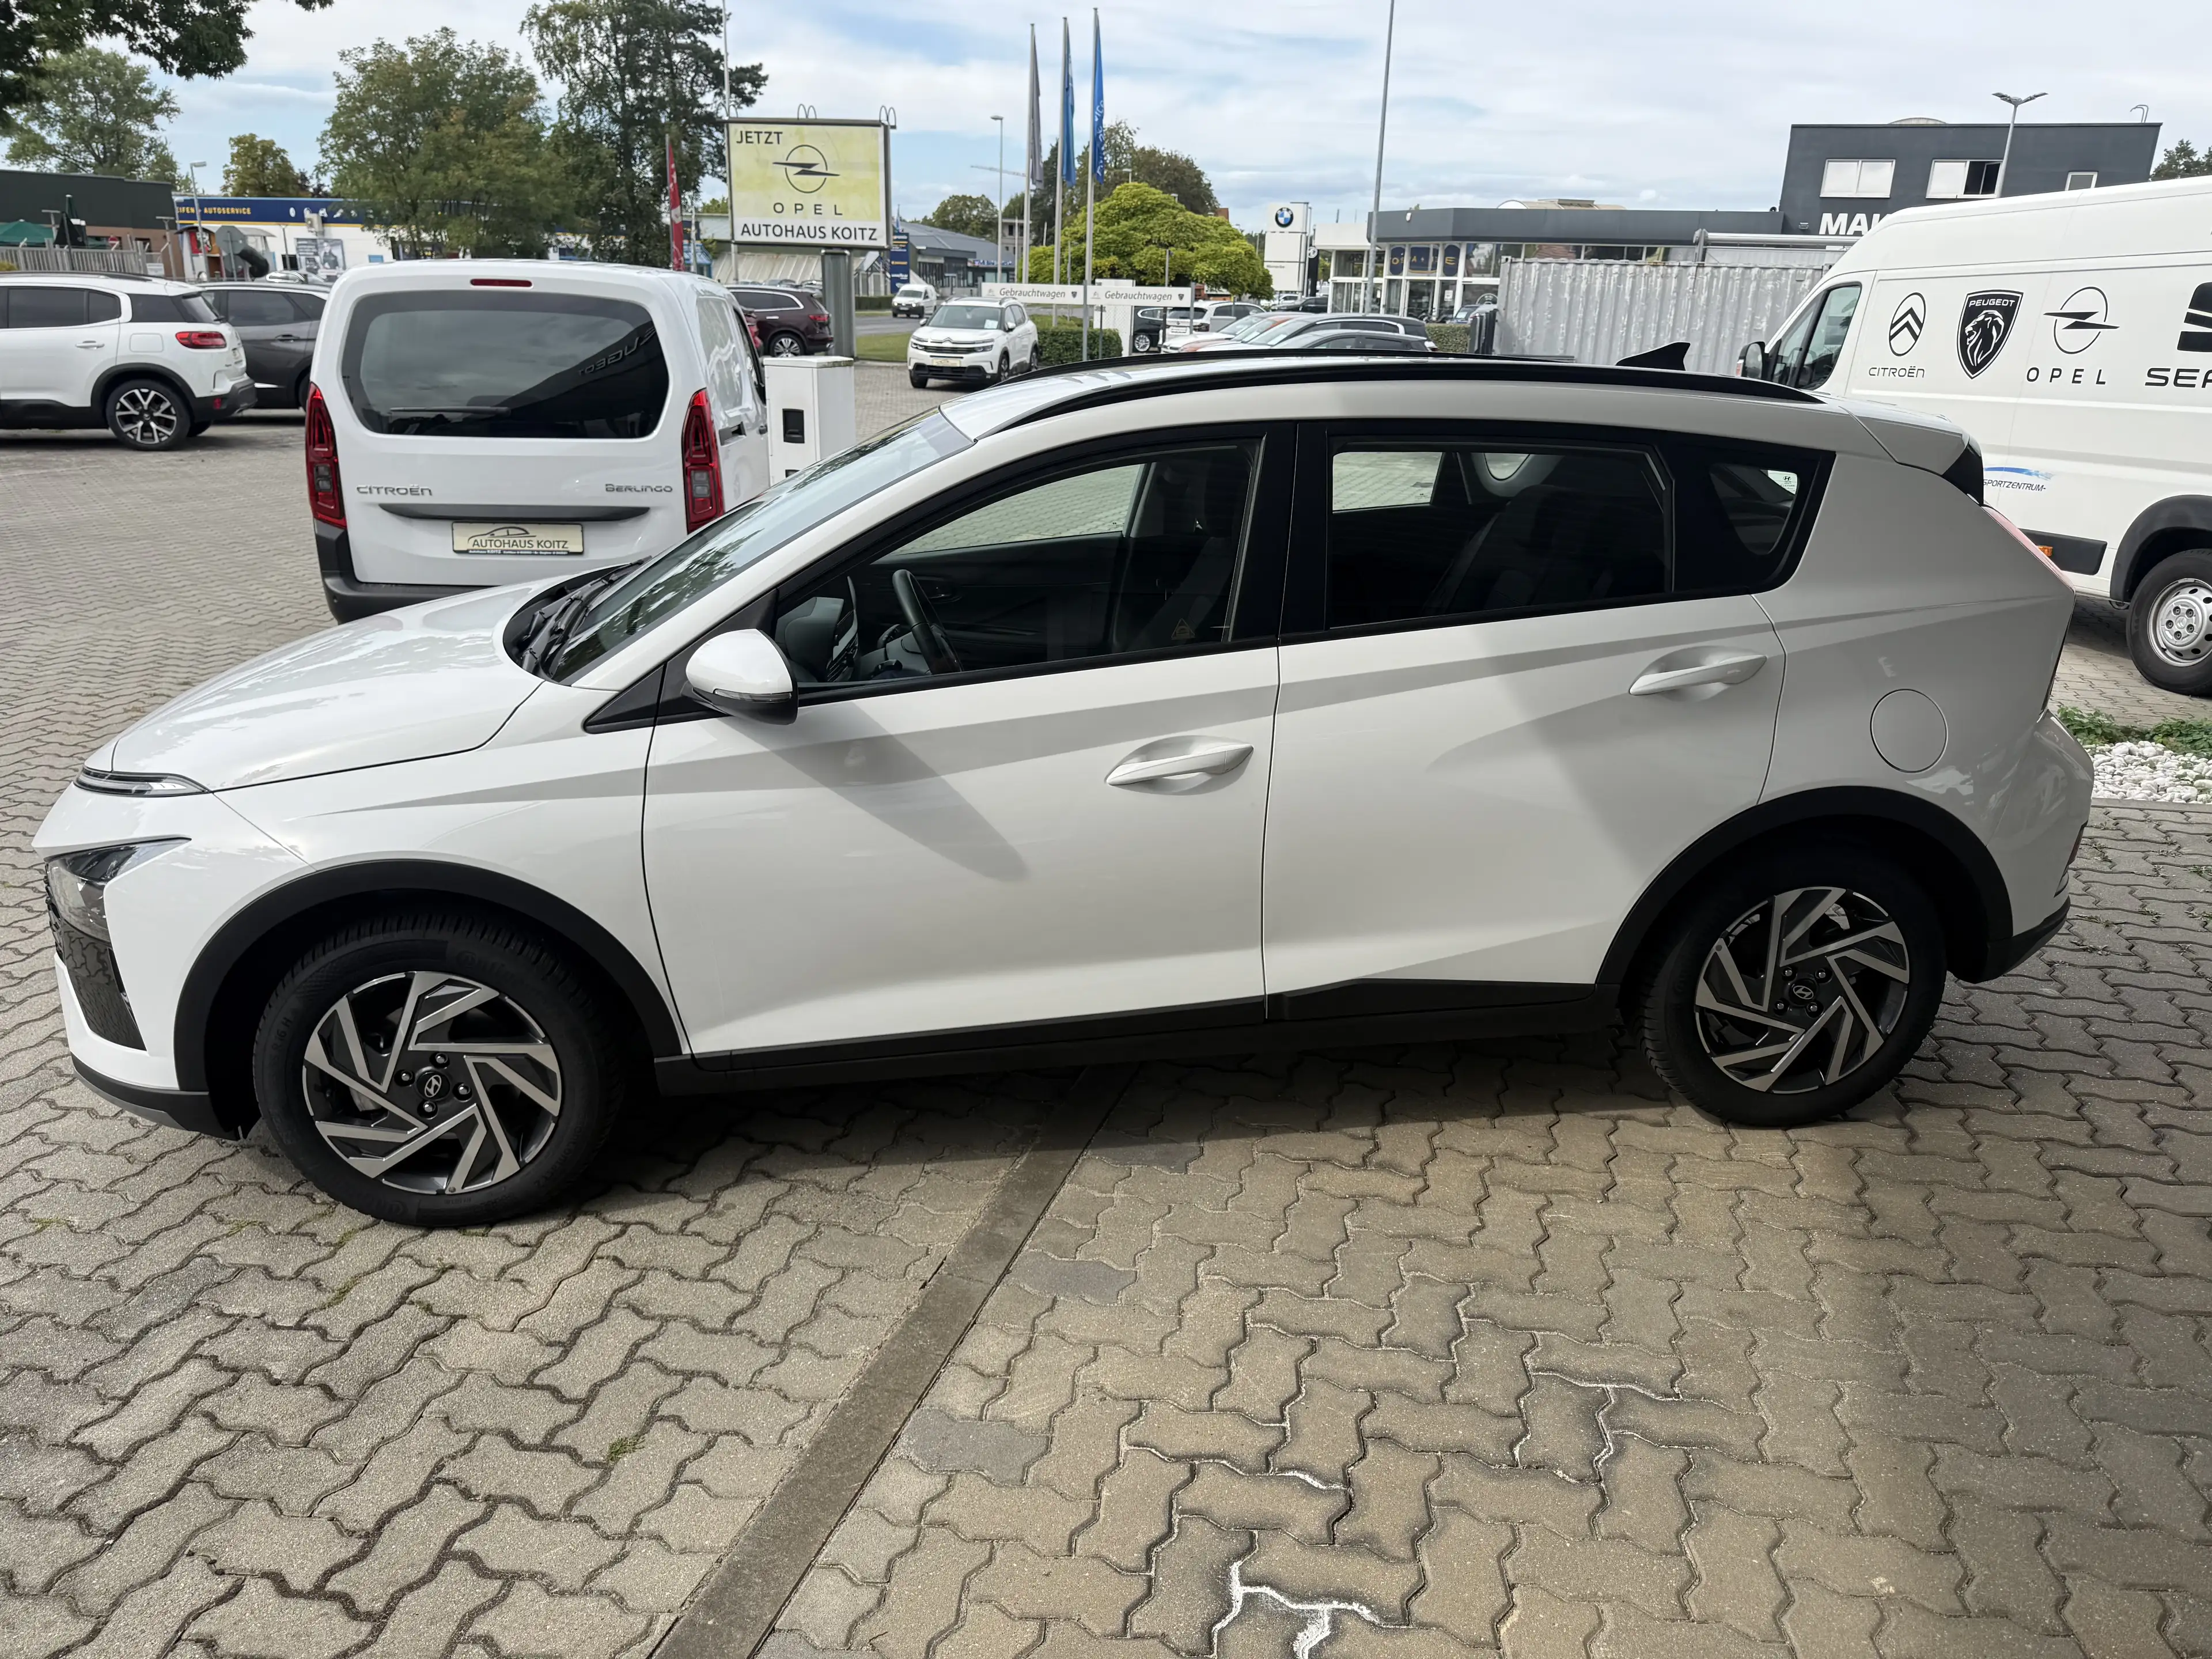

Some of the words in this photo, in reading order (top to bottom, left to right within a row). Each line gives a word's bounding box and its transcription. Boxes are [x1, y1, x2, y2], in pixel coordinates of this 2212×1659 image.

[736, 131, 783, 145] JETZT
[773, 202, 843, 215] OPEL
[741, 224, 826, 239] AUTOHAUS
[832, 226, 878, 241] KOITZ
[999, 288, 1066, 299] Gebrauchtwagen
[1105, 291, 1172, 301] Gebrauchtwagen
[1968, 298, 2016, 308] PEUGEOT
[1868, 365, 1925, 378] CITROËN
[2025, 366, 2107, 385] OPEL
[472, 539, 534, 548] AUTOHAUS
[537, 540, 569, 549] KOITZ
